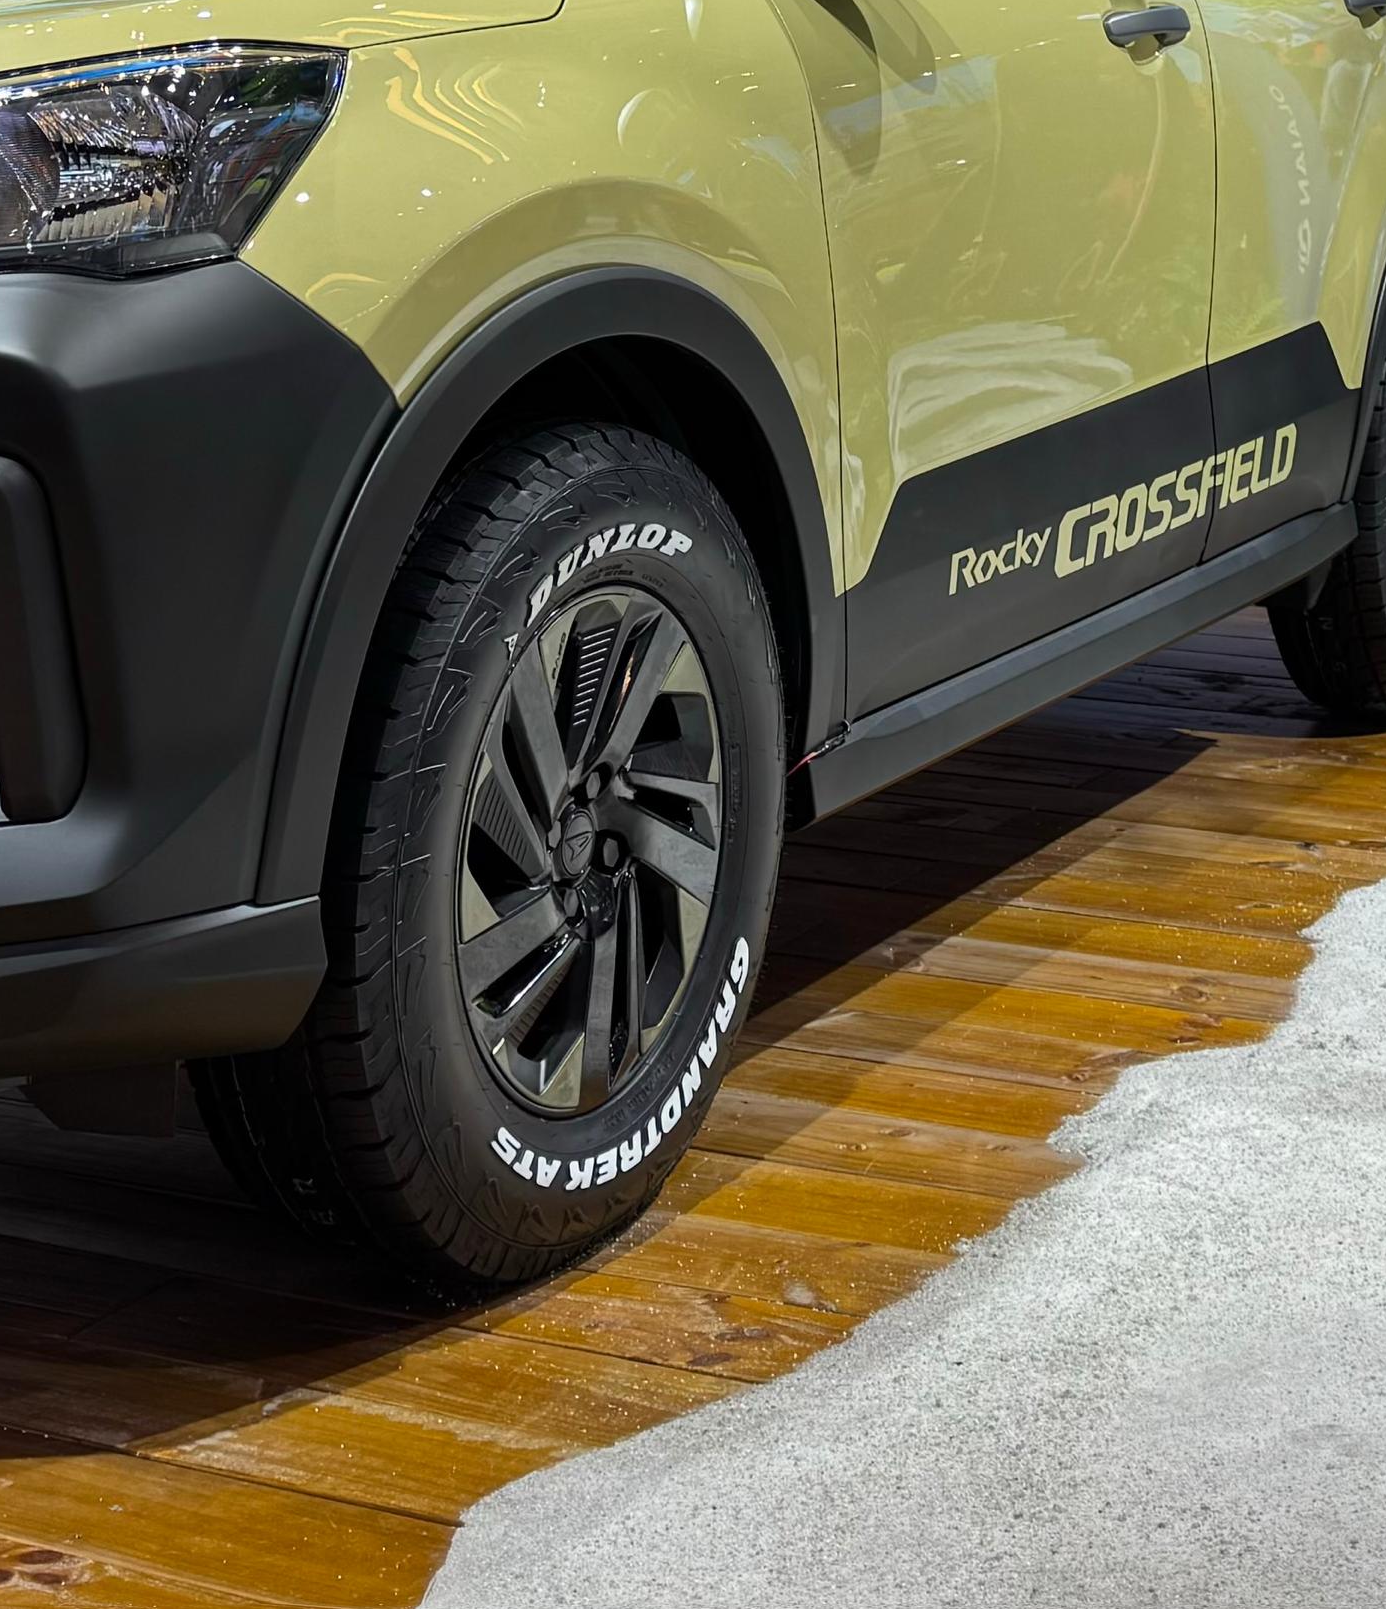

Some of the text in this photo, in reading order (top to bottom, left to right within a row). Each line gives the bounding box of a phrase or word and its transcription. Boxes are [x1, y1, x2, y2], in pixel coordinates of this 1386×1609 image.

[526, 523, 693, 628] DUNLOP
[948, 423, 1298, 596] Rocky CROSSFIELD
[565, 936, 750, 1191] GRANDTREK
